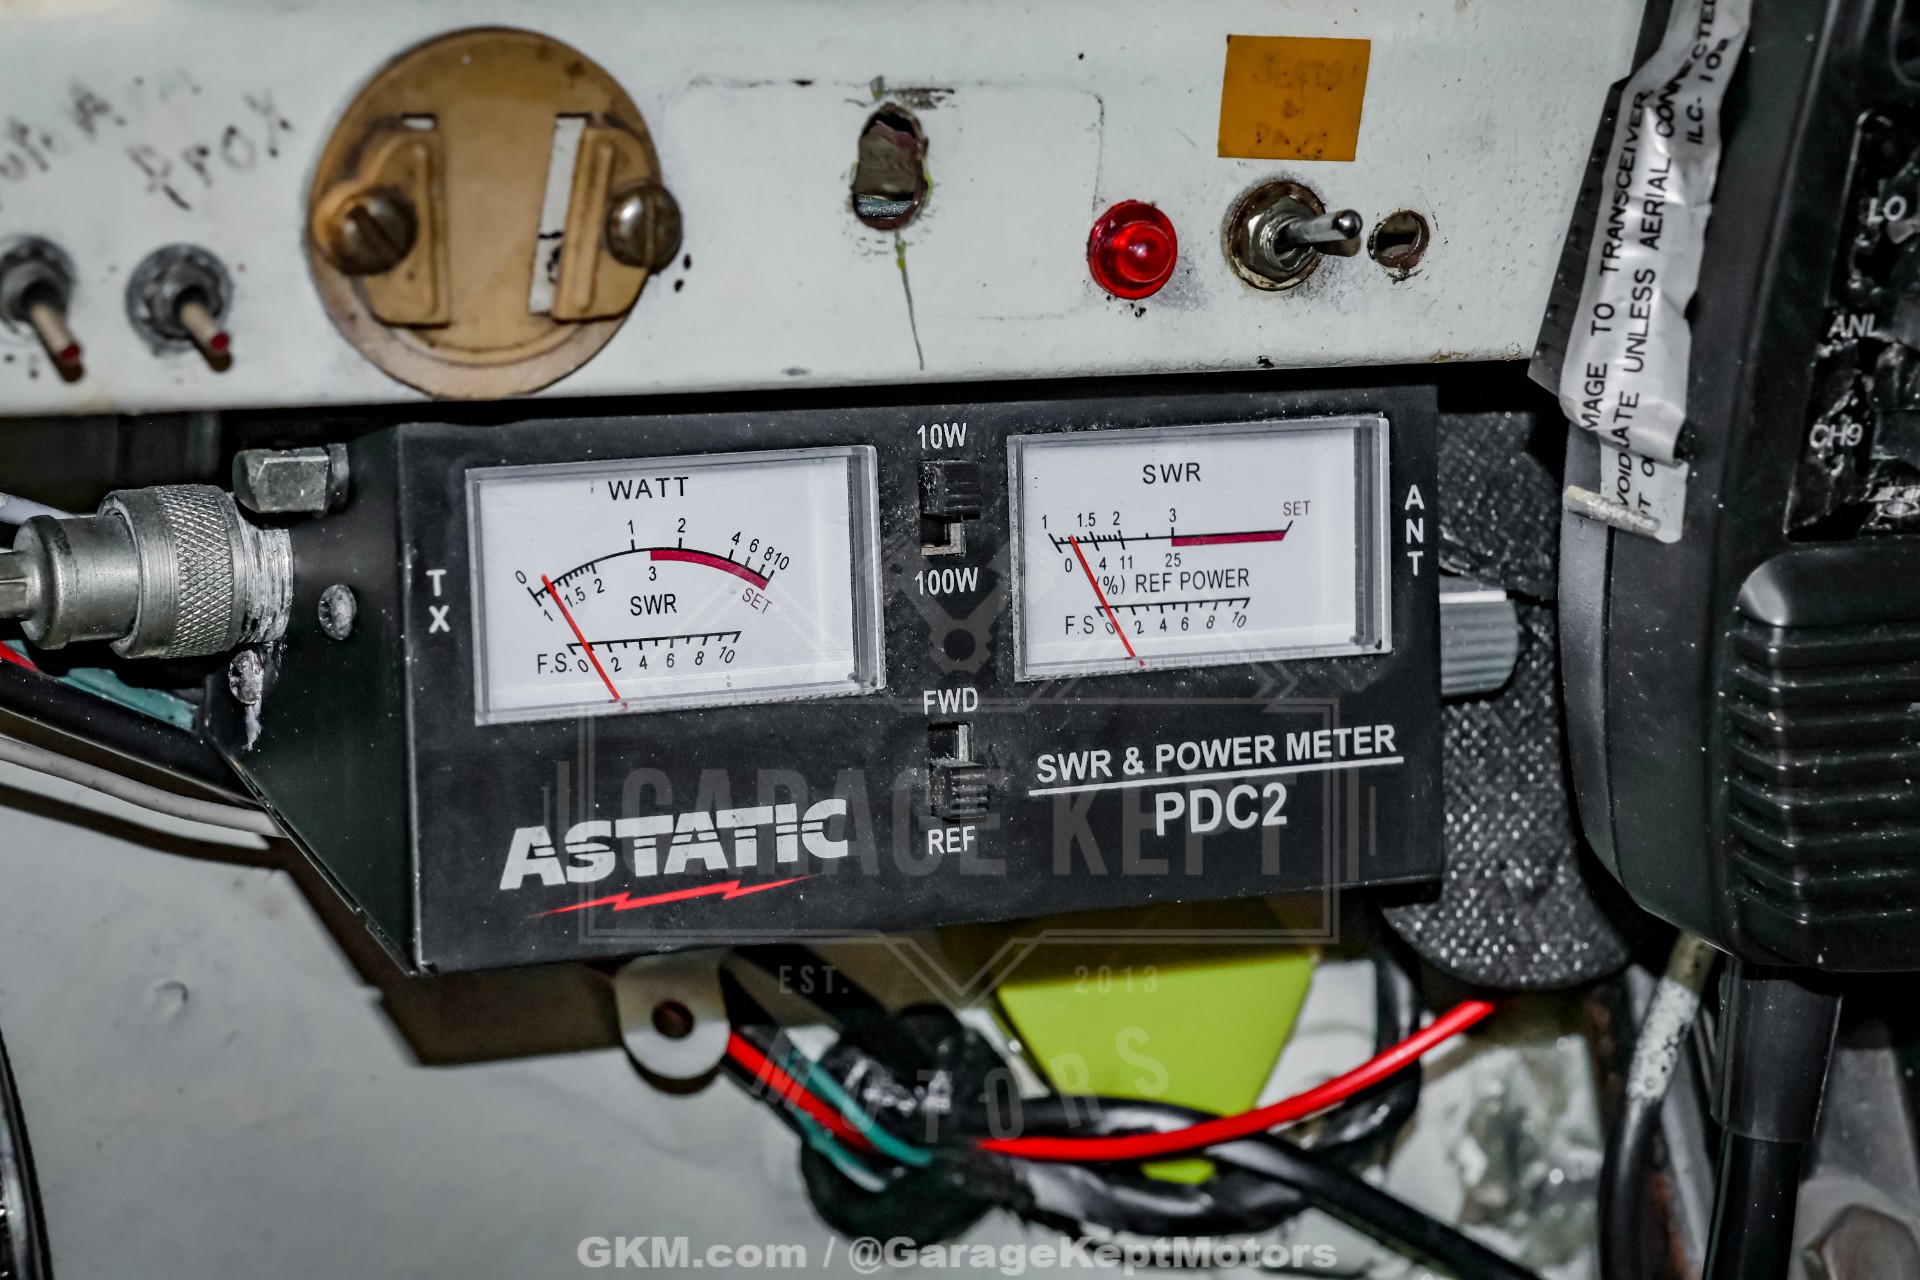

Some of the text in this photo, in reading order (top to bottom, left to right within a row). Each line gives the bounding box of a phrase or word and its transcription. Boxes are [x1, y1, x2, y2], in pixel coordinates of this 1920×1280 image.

[1639, 157, 1672, 251] AERIAL
[1867, 195, 1907, 225] LO
[1591, 303, 1615, 336] TO
[1623, 268, 1656, 373] UNLESS
[1828, 314, 1878, 338] ANL
[1611, 391, 1640, 449] ATE
[917, 422, 967, 449] 10W
[1809, 424, 1863, 449] CH9
[608, 476, 689, 500] WATT
[1142, 462, 1201, 485] SWR
[1041, 501, 1311, 529] 1 1.5 2 3 SET
[1404, 484, 1426, 577] ANT
[515, 518, 790, 584] 0 1 2 4 6 8 10
[1064, 553, 1181, 573] 0 4 11 25
[543, 566, 773, 622] 1 1.5 2 3 SET
[914, 566, 979, 595] 100W
[1135, 573, 1172, 594] REF
[1180, 568, 1250, 592] POWER
[425, 568, 450, 634] TX
[630, 594, 678, 616] SWR
[1105, 621, 1115, 635] 0
[1134, 620, 1144, 635] 2
[1159, 617, 1168, 633] 4
[1181, 616, 1190, 631] 6
[1206, 614, 1216, 630] 8
[1231, 610, 1248, 629] 10
[537, 645, 736, 674] F.S. 0 2 4 6 8 10
[923, 686, 979, 715] FWD
[1036, 724, 1396, 783] SWR & POWER METER
[1155, 782, 1288, 836] PDC2
[499, 798, 848, 890] ASTATIC
[927, 825, 976, 856] REF
